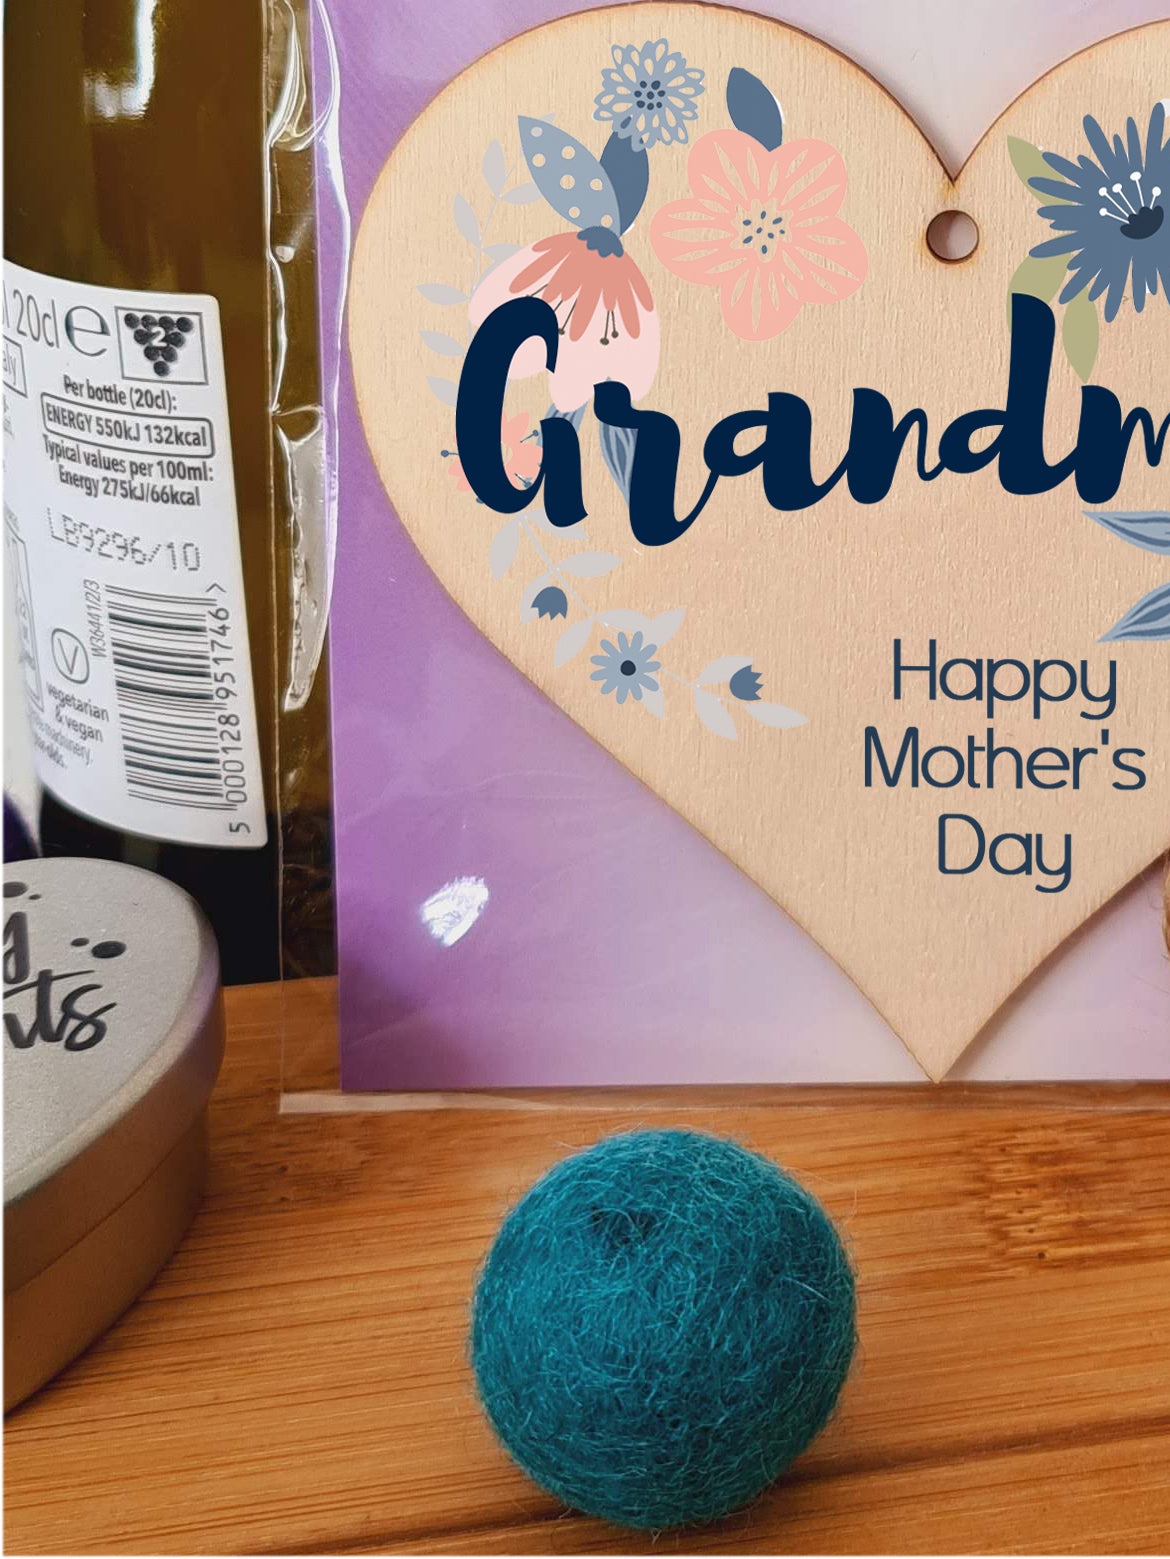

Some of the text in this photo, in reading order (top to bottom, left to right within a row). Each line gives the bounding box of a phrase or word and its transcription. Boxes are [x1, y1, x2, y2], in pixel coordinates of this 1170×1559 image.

[13, 289, 60, 349] 20cl
[63, 374, 178, 414] Per bottle (20cl):
[45, 402, 208, 447] ENERGY 550kJ 132kcal
[42, 434, 215, 482] Typical values per 100ml:
[58, 464, 201, 506] Energy 275kJ/66kcal
[46, 681, 110, 722] vegetarian
[891, 638, 1118, 720] Happy
[55, 702, 105, 742] & vegan
[208, 607, 251, 834] 5 000128 951746
[863, 725, 1147, 792] Mother's
[937, 813, 1073, 894] Day
